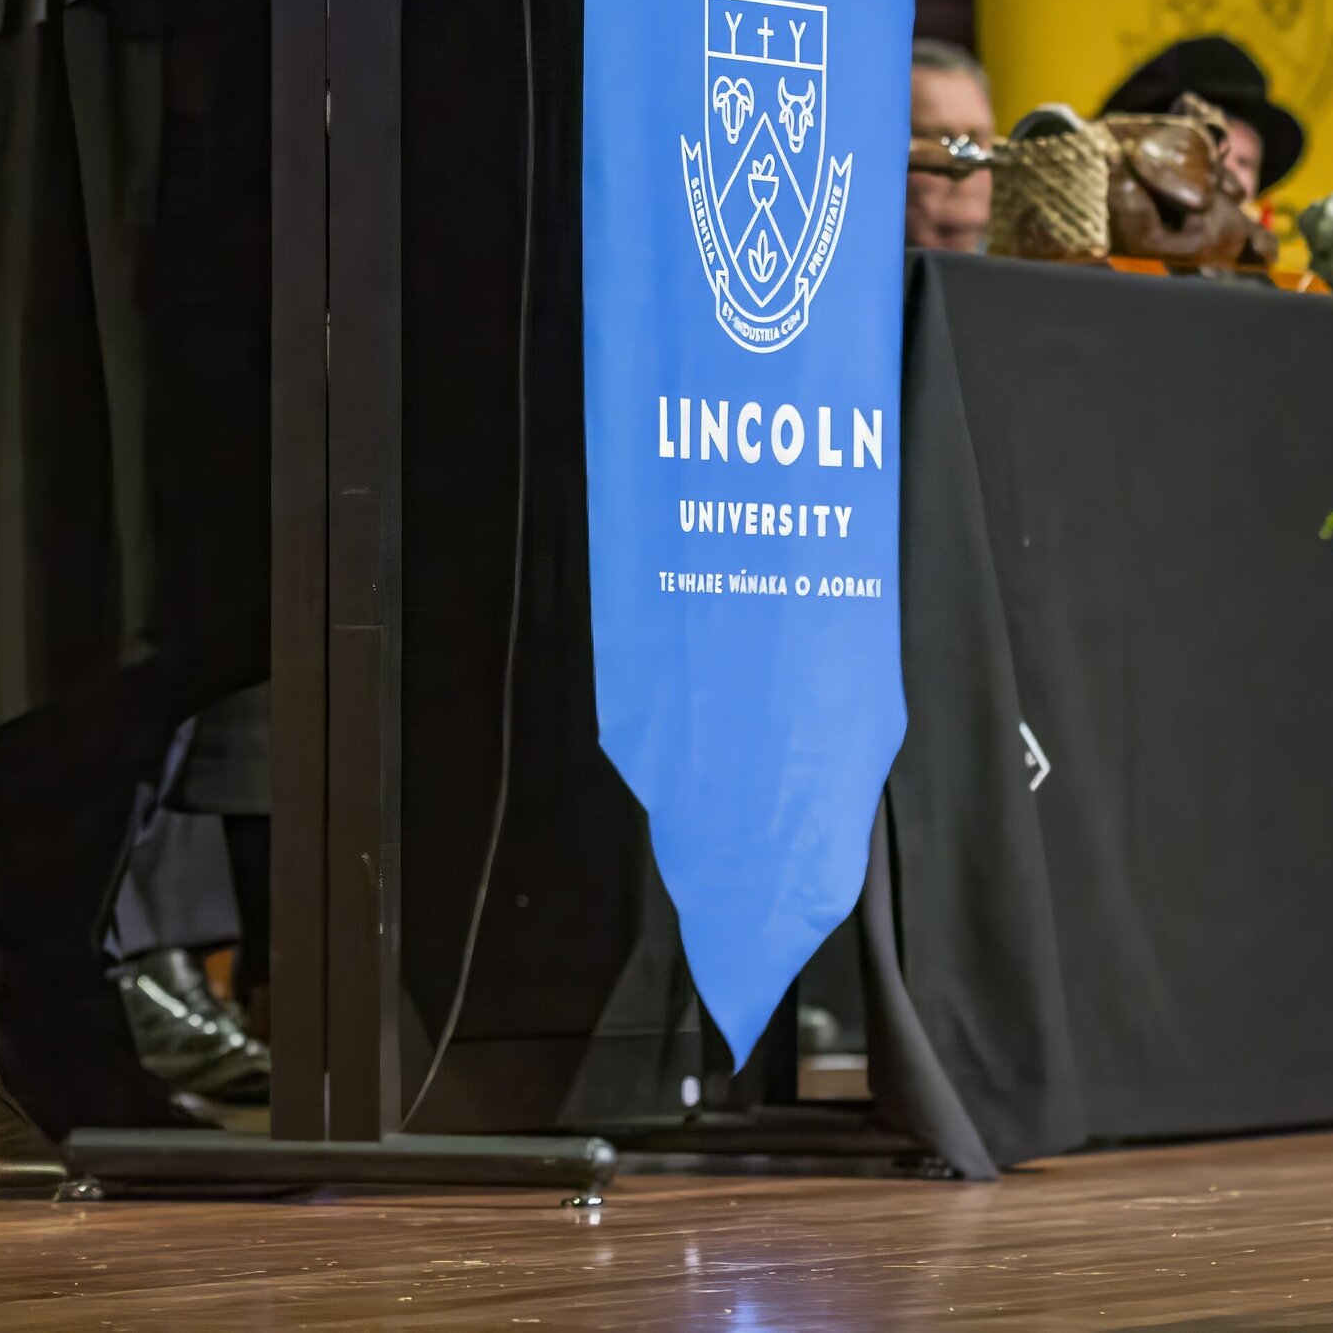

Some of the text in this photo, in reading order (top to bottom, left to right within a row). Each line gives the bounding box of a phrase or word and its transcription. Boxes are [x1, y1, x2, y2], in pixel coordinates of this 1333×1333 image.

[659, 396, 883, 470] LINCOLN
[679, 500, 852, 538] UNIVERSITY
[659, 571, 675, 592] TE
[795, 576, 811, 597] O
[817, 576, 882, 598] AORAKI
